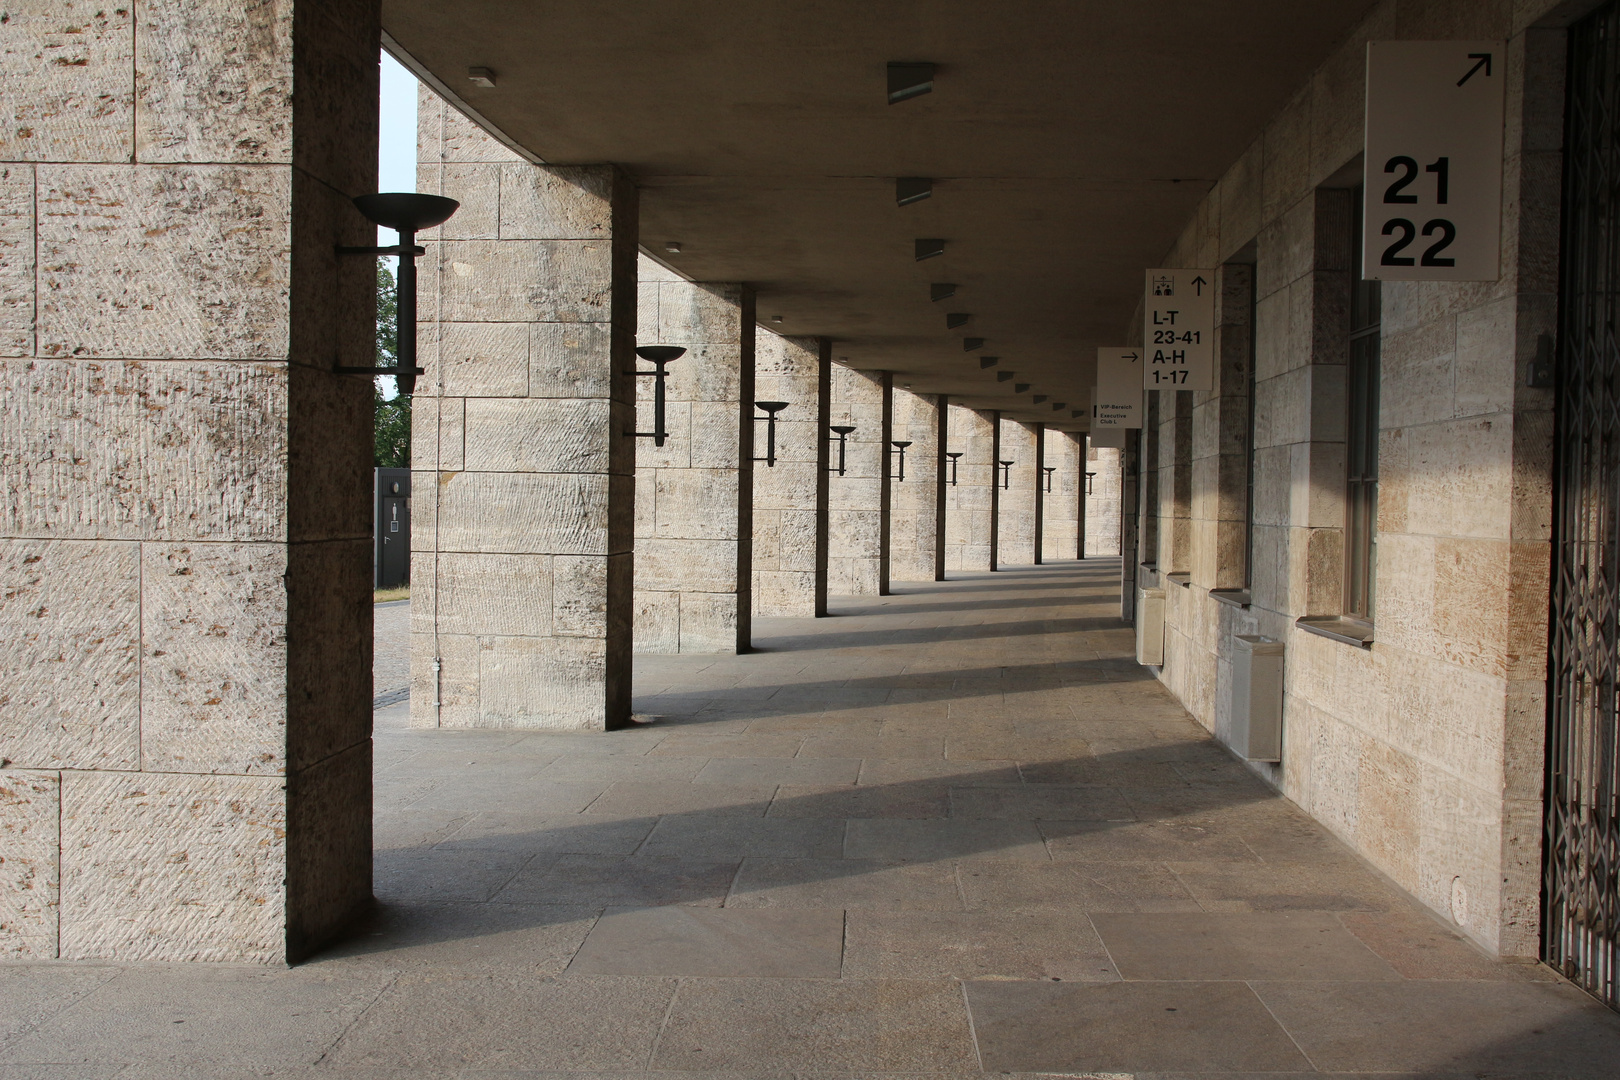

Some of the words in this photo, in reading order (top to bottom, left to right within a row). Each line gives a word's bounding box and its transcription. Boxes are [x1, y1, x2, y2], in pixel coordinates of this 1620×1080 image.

[1383, 155, 1449, 205] 21
[1380, 217, 1456, 268] 22
[1153, 310, 1179, 325] L-T
[1153, 330, 1201, 345] 23-41
[1152, 349, 1185, 365] A-H
[1152, 370, 1189, 384] 1-17
